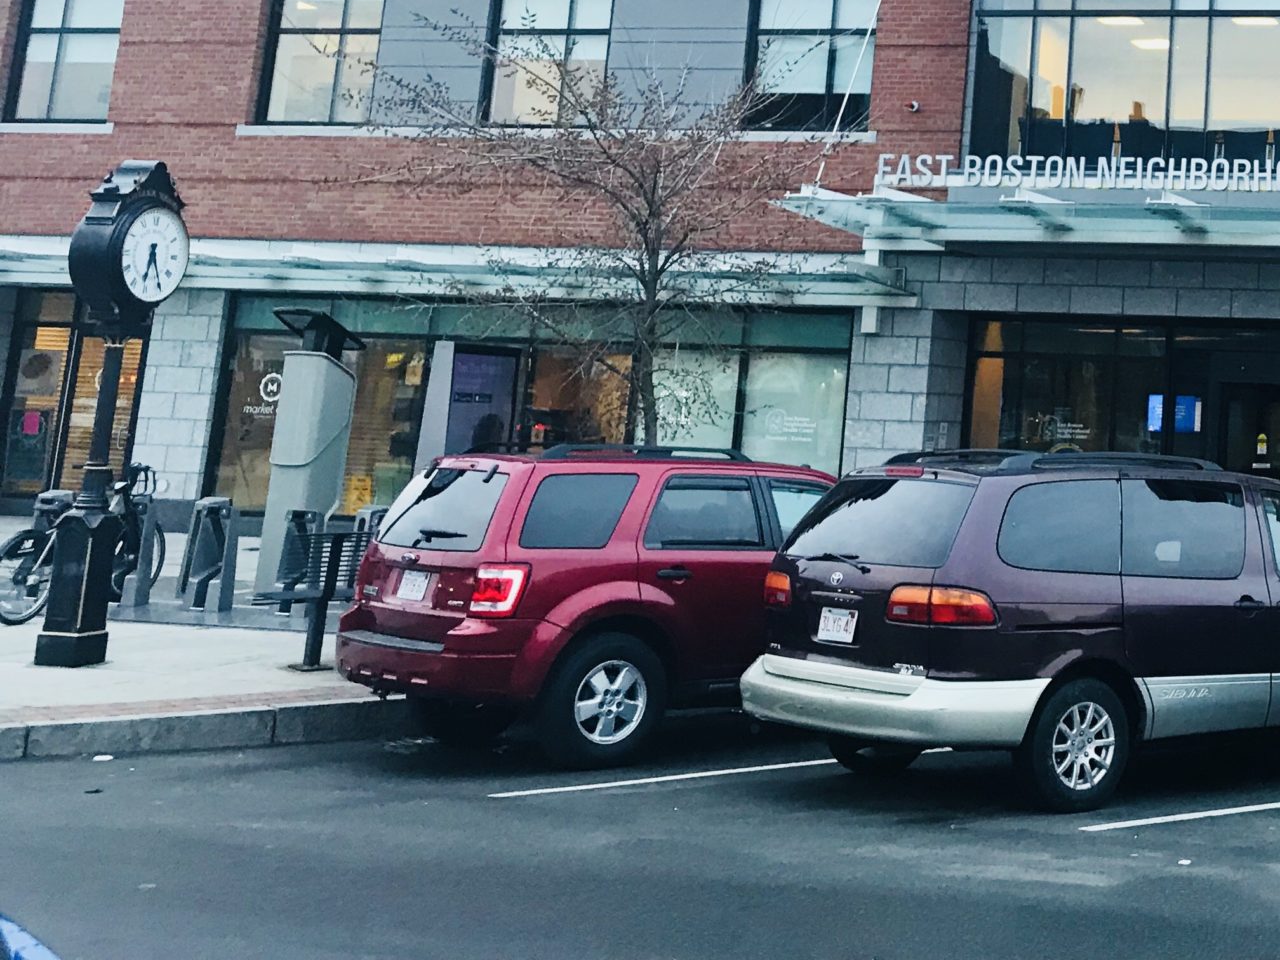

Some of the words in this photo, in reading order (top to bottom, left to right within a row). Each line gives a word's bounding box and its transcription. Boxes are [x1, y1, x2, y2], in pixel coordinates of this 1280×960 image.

[877, 153, 954, 187] EAST
[963, 154, 1085, 188] BOSTON
[266, 381, 278, 392] M
[242, 402, 274, 414] market
